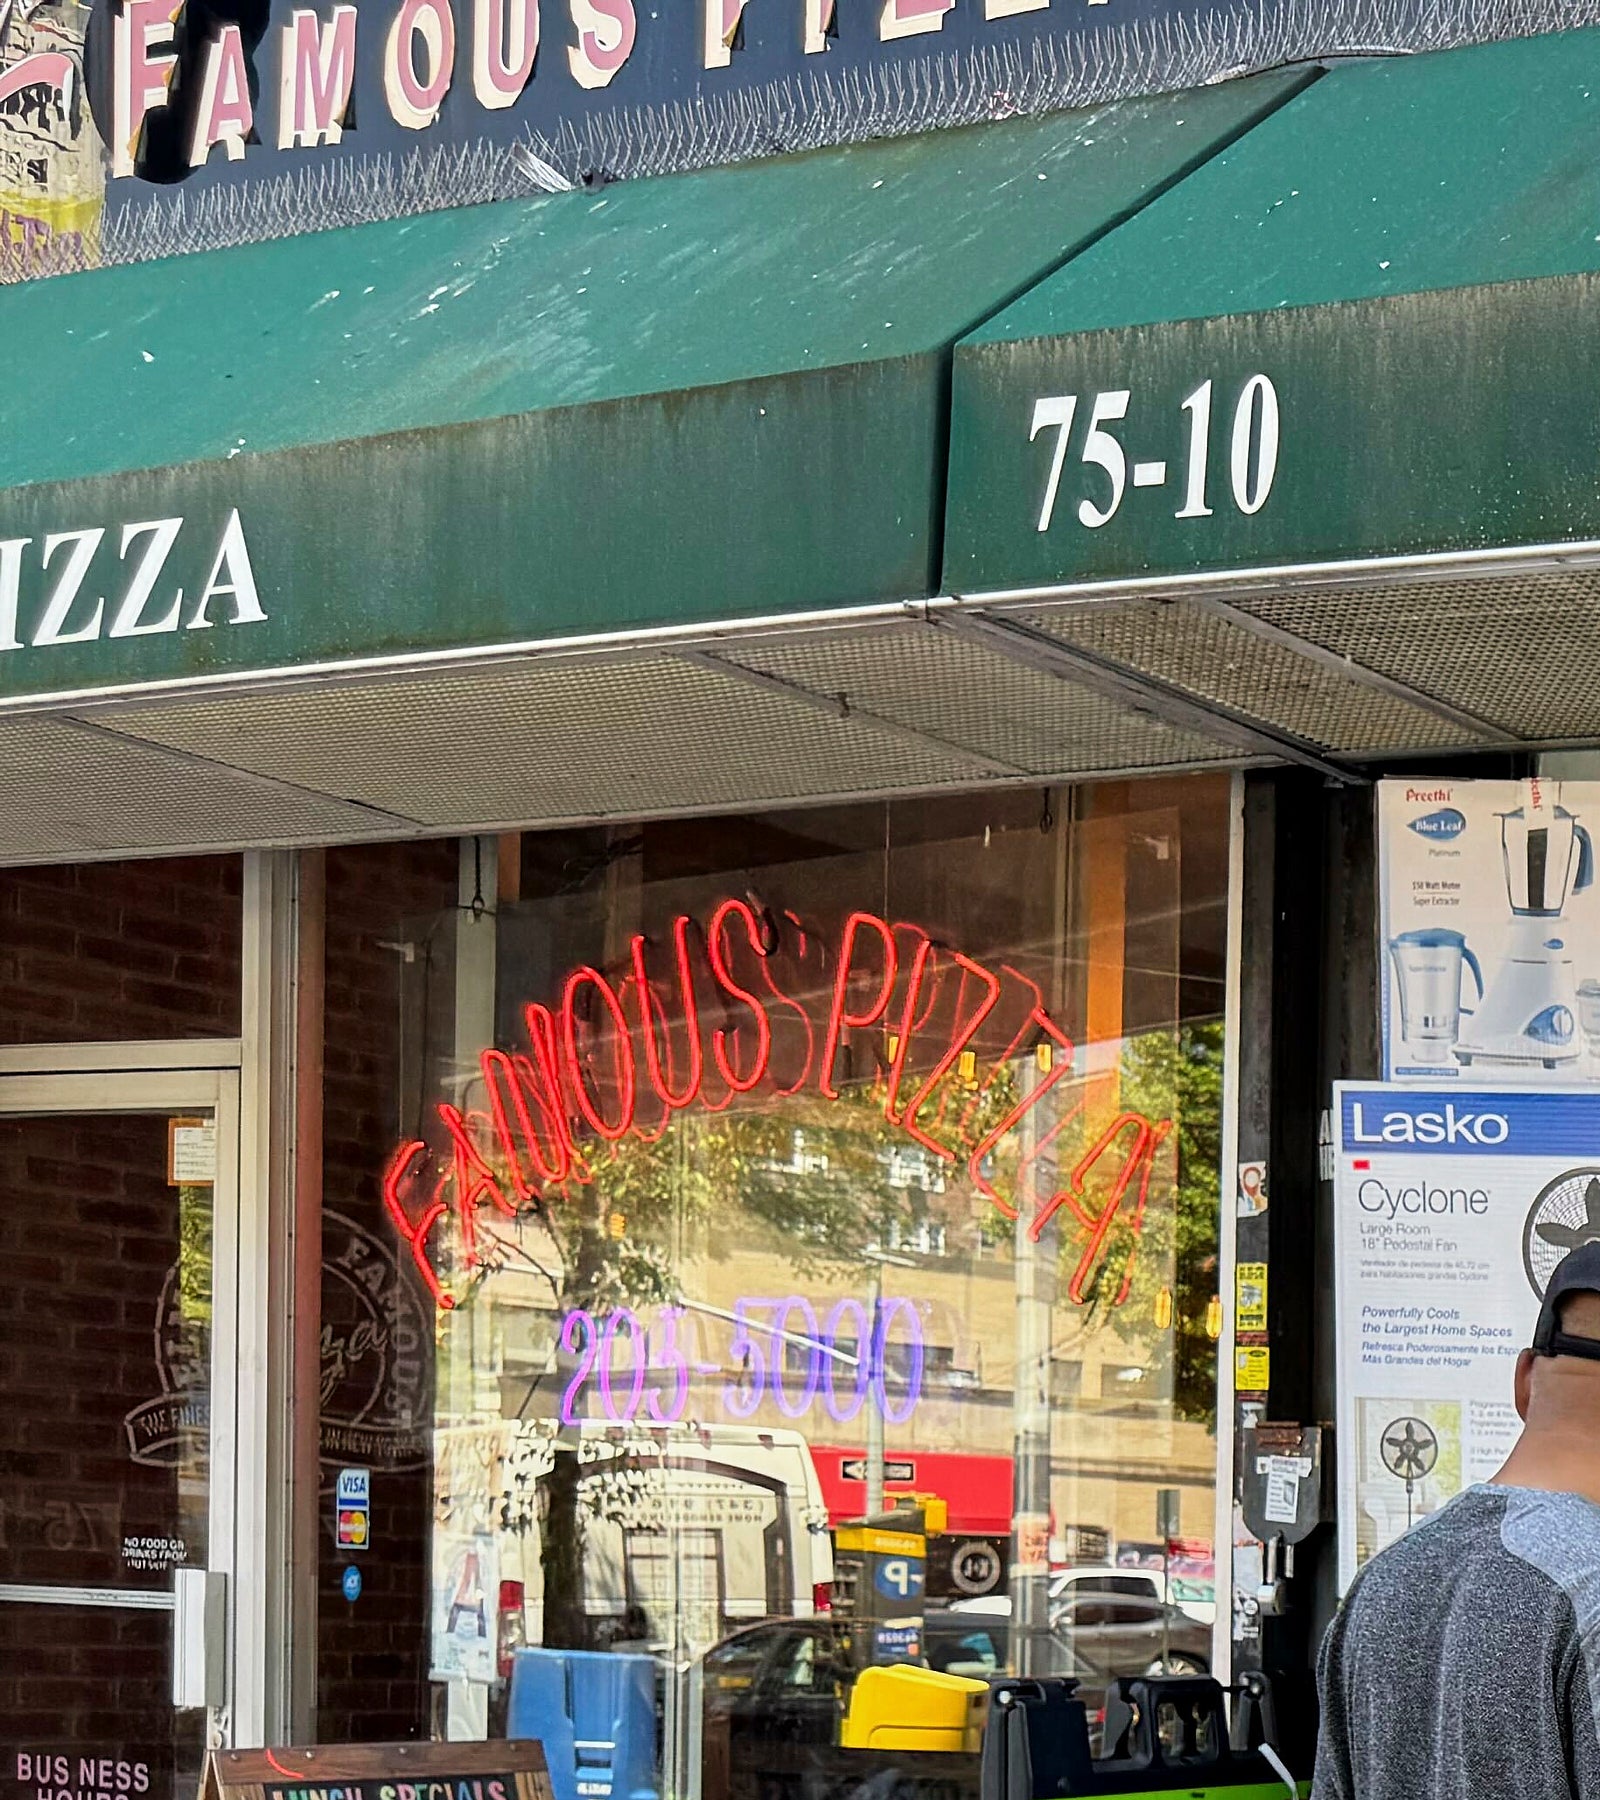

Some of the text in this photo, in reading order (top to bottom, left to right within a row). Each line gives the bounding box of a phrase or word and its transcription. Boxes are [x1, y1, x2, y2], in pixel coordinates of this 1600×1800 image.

[112, 0, 636, 178] FAMOUS
[1028, 374, 1280, 532] 75-10
[383, 897, 1160, 1309] FAMOUS PIZZA
[1352, 1102, 1507, 1145] Lasko
[1358, 1179, 1489, 1220] Cyclone
